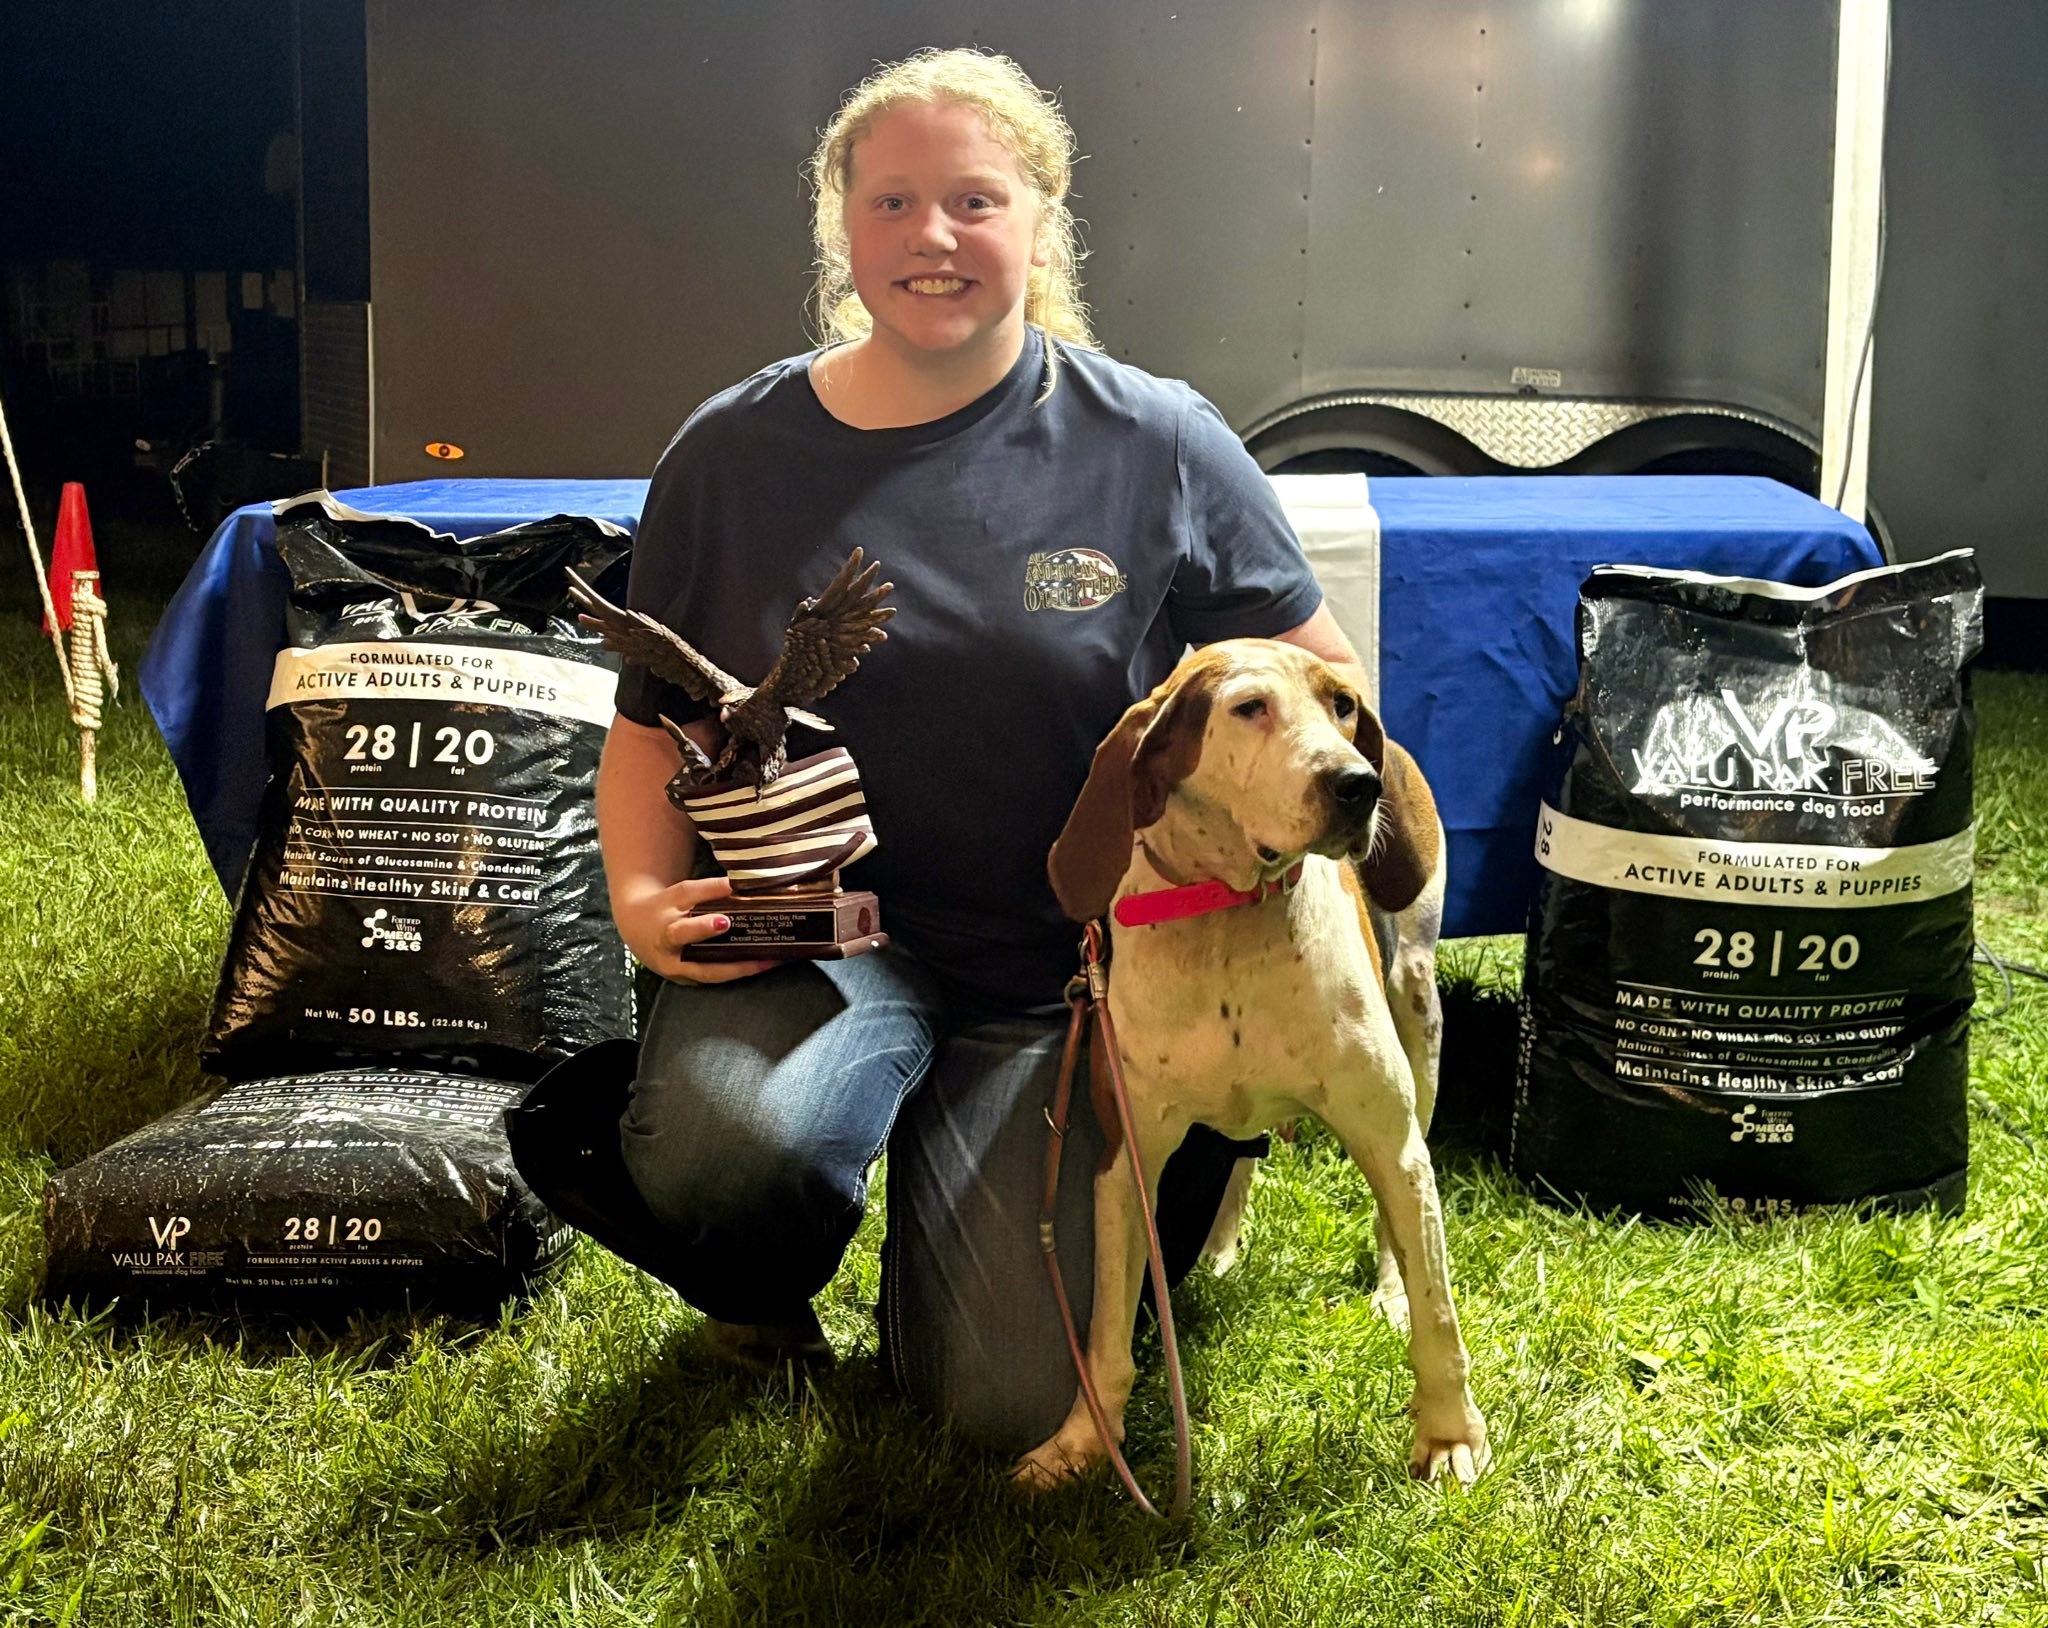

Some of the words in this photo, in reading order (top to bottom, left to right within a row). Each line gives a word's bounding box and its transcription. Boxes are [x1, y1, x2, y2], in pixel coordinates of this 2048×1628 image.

[349, 652, 454, 669] FORMULATED
[461, 656, 494, 671] FOR
[295, 672, 358, 690] ACTIVE
[366, 672, 442, 689] ADULTS
[450, 674, 463, 690] &
[473, 676, 558, 702] PUPPIES
[1720, 688, 1836, 760] VP
[343, 724, 396, 761] 28
[433, 726, 495, 766] 20
[350, 762, 382, 774] protein
[450, 766, 466, 776] fat
[1631, 746, 1736, 790] VALU
[1752, 758, 1830, 793] PAK
[1841, 757, 1940, 796] FREE
[330, 796, 374, 811] WITH
[379, 797, 461, 815] QUALITY
[466, 801, 548, 825] PROTEIN
[1679, 791, 1796, 814] performance
[1801, 796, 1836, 819] dog
[1841, 798, 1886, 818] food
[288, 824, 302, 836] NO
[336, 829, 354, 839] NO
[358, 829, 400, 841] WHEAT
[411, 831, 431, 842] NO
[434, 832, 460, 843] SOY
[473, 834, 493, 846] NO
[497, 836, 545, 851] GLUTEN
[283, 849, 316, 861] Natural
[357, 855, 371, 866] of
[374, 855, 453, 870] Glucosamine
[457, 860, 466, 871] &
[470, 861, 542, 876] Chondroitin
[1697, 851, 1817, 871] FORMULATED
[1825, 858, 1861, 873] FOR
[279, 870, 349, 890] Maintains
[354, 876, 424, 898] Healthy
[430, 880, 470, 897] Skin
[477, 883, 490, 899] &
[498, 884, 540, 902] Coat
[1624, 863, 1706, 889] ACTIVE
[1715, 872, 1805, 896] ADULTS
[1813, 880, 1829, 897] &
[1839, 874, 1922, 897] PUPPIES
[373, 927, 423, 942] OMEGA
[1692, 928, 1755, 969] 28
[1796, 934, 1861, 971] 20
[1702, 969, 1740, 982] protein
[1814, 972, 1831, 983] fat
[1615, 989, 1673, 1010] MADE
[1680, 999, 1731, 1018] WITH
[1738, 1004, 1824, 1020] QUALITY
[1829, 996, 1906, 1018] PROTEIN
[304, 1008, 323, 1019] Net
[325, 1009, 343, 1020] Wt.
[348, 1007, 376, 1025] 50
[383, 1009, 427, 1028] LBS.
[431, 1017, 464, 1028] (22.68
[466, 1018, 488, 1031] Kg.)
[1614, 1017, 1636, 1031] NO
[1639, 1022, 1678, 1038] CORN
[1691, 1028, 1713, 1042] NO
[1715, 1031, 1760, 1043] WHEAT
[1774, 1032, 1793, 1044] NO
[1834, 1031, 1856, 1042] NO
[1616, 1037, 1665, 1055] Natural
[1717, 1050, 1730, 1061] of
[1735, 1051, 1819, 1067] Glucosamine
[1823, 1056, 1832, 1067] &
[232, 1079, 291, 1091] MADE
[295, 1076, 346, 1085] WITH
[348, 1074, 433, 1085] QUALITY
[436, 1078, 520, 1097] PROTEIN
[1615, 1059, 1711, 1087] Maintains
[1717, 1070, 1788, 1093] Healthy
[1795, 1075, 1836, 1091] Skin
[1842, 1074, 1857, 1086] &
[1862, 1063, 1905, 1083] Coat
[426, 1098, 502, 1113] Chondroitin
[448, 1112, 495, 1127] Coat
[1743, 1122, 1795, 1134] OMEGA
[251, 1140, 287, 1149] 50
[148, 1216, 192, 1251] VP
[283, 1216, 321, 1242] 28
[344, 1217, 382, 1242] 20
[111, 1252, 151, 1267] VALU
[156, 1252, 186, 1266] PAK
[188, 1251, 225, 1267] FREE
[246, 1256, 299, 1266] FORMULATED
[301, 1256, 317, 1265] FOR
[319, 1257, 347, 1266] ACTIVE
[349, 1257, 380, 1266] ADULTS
[382, 1258, 389, 1266] &
[391, 1257, 423, 1267] PUPPIES
